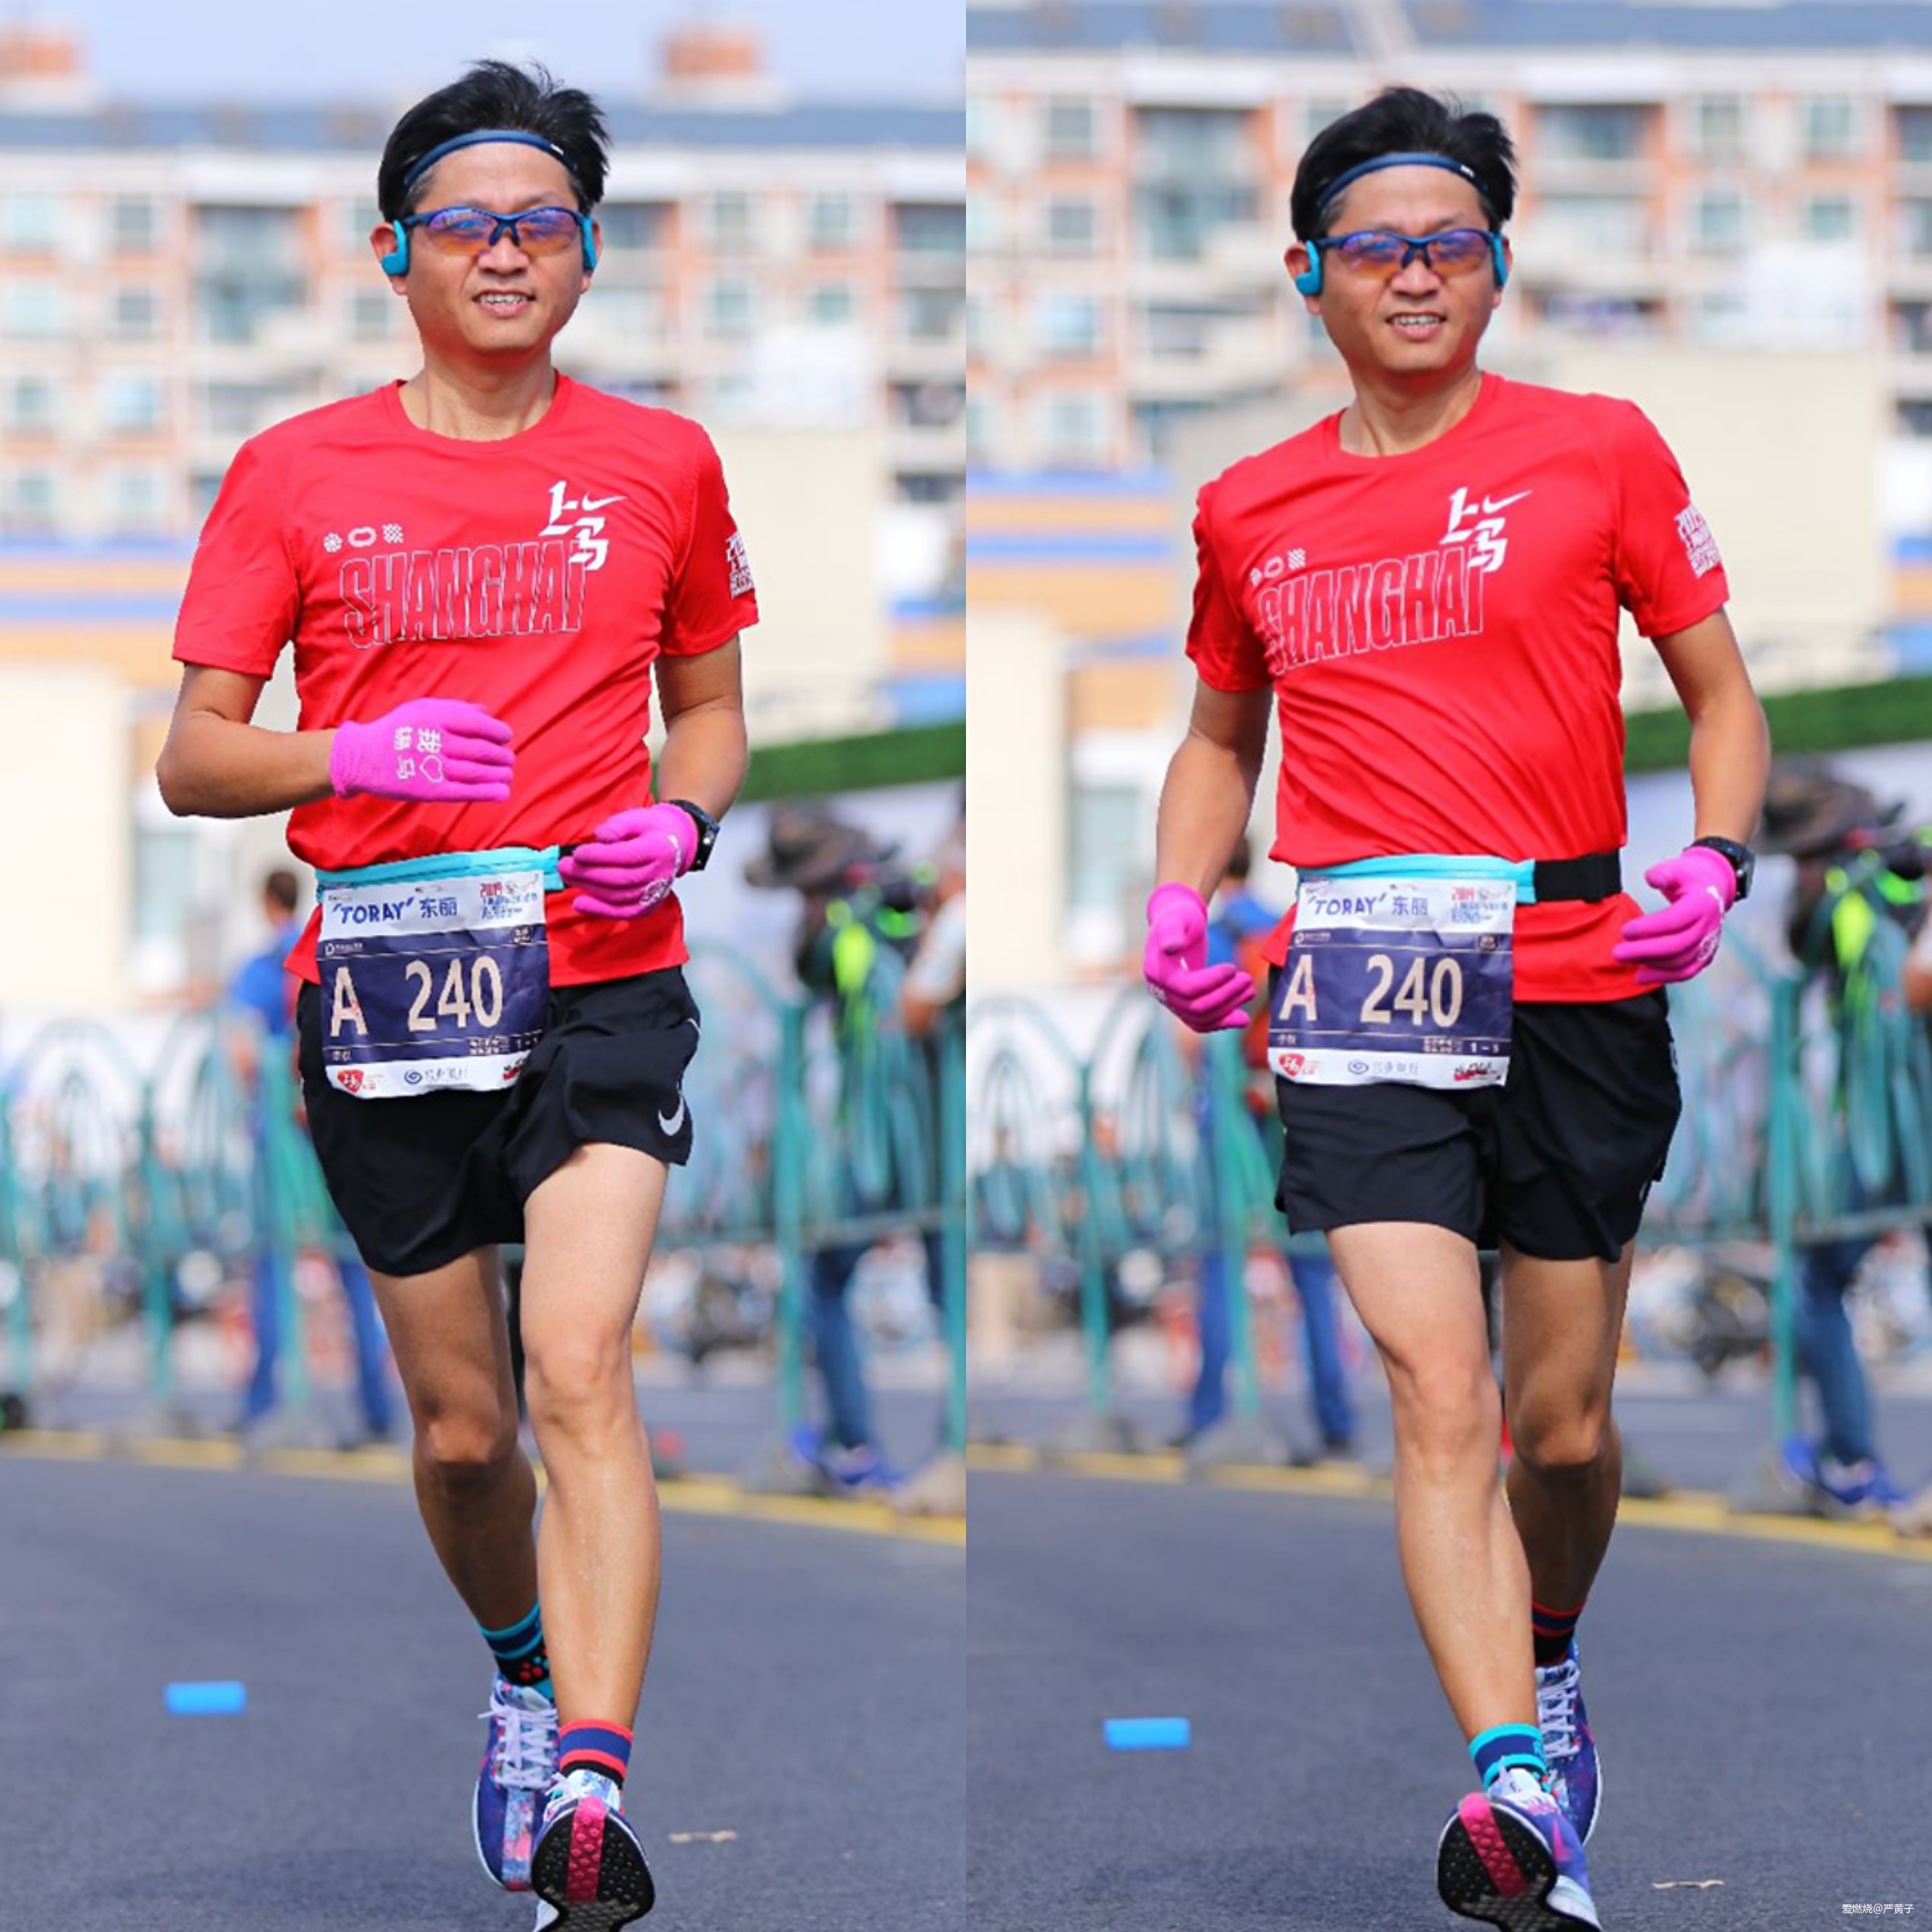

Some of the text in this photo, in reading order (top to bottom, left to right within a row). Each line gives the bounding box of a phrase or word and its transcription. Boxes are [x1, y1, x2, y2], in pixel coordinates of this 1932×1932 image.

[339, 540, 586, 649] SHANGHAI
[1258, 544, 1484, 677] SHANGHAI
[420, 897, 459, 918] 东丽
[1392, 896, 1428, 916] 东丽
[330, 956, 503, 1037] A 240
[1279, 954, 1463, 1027] A 240
